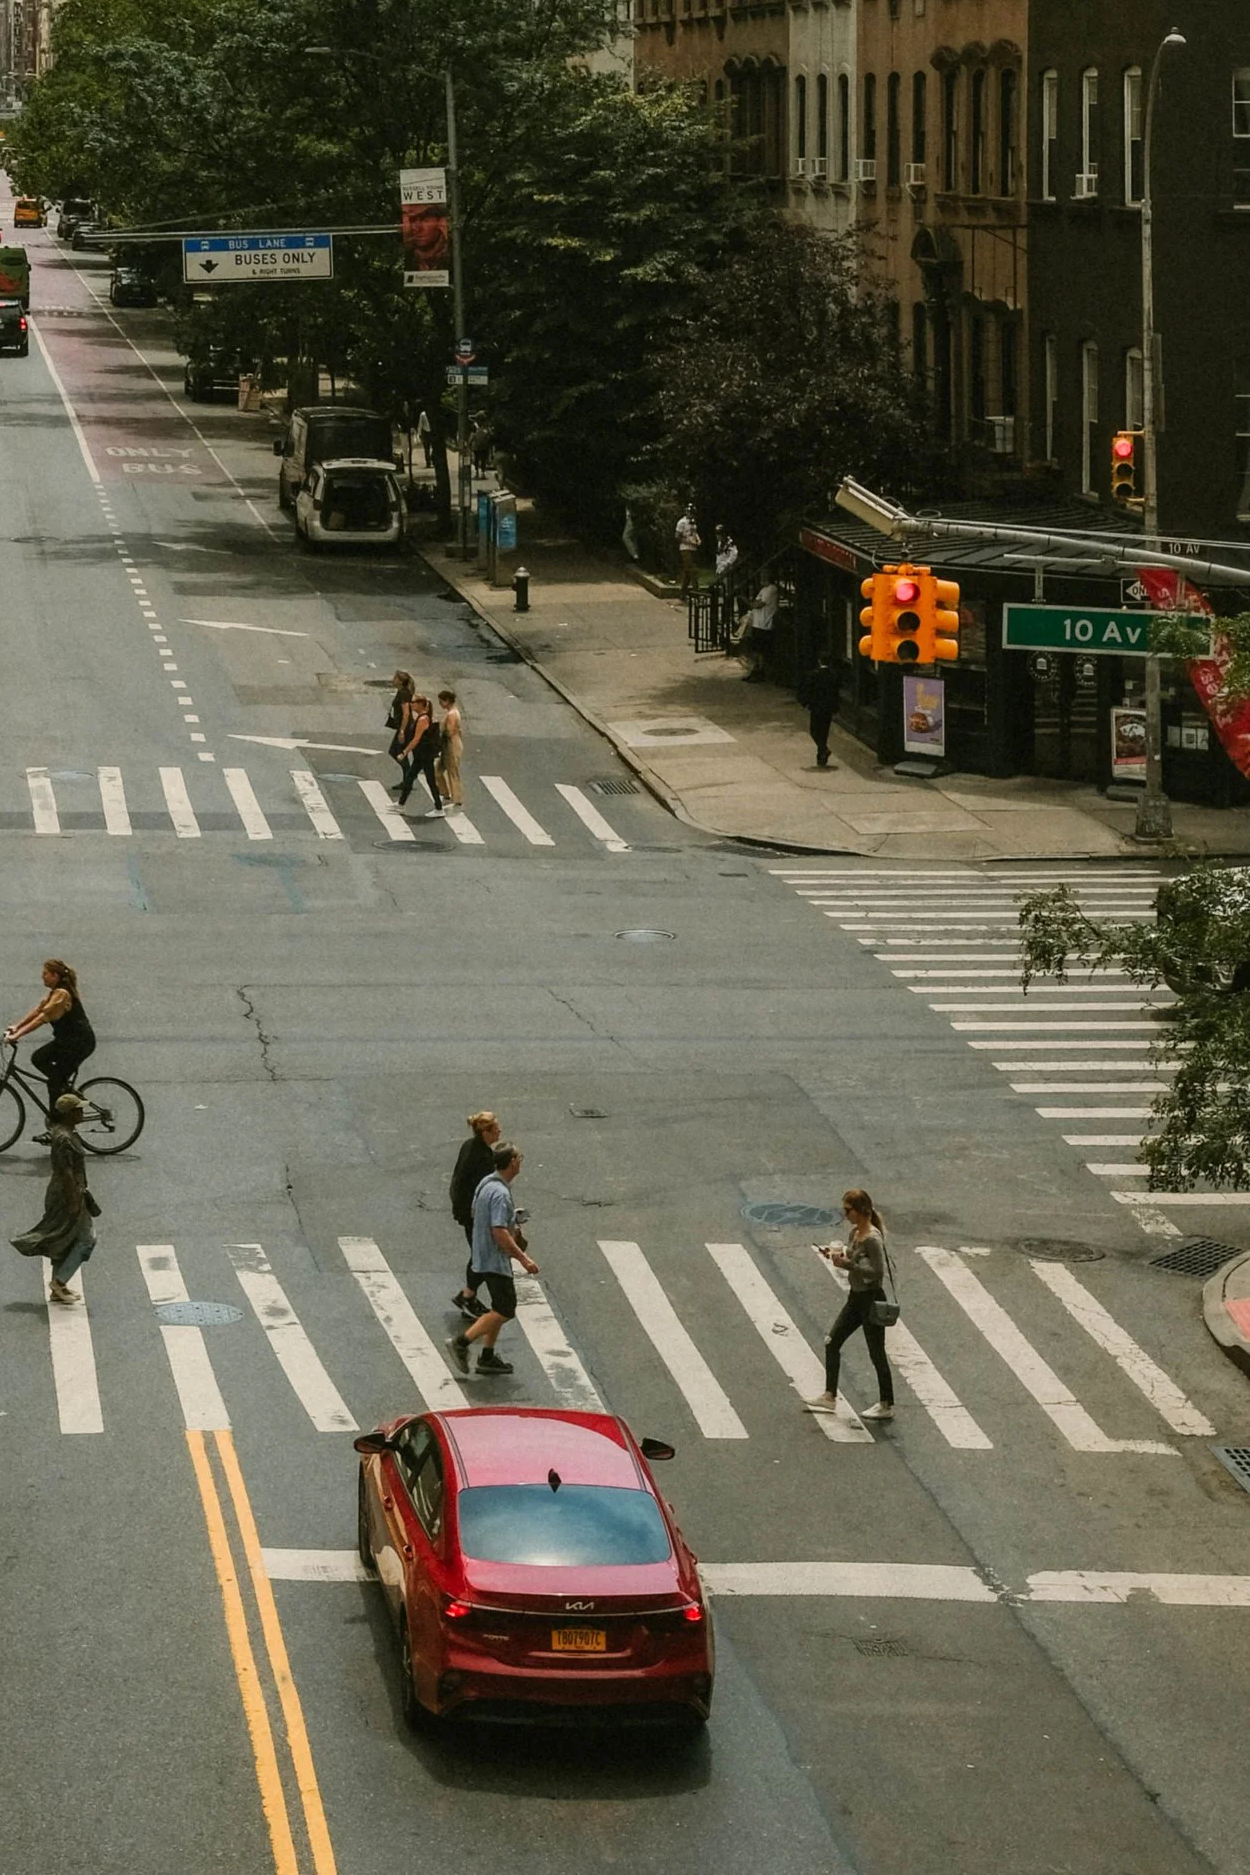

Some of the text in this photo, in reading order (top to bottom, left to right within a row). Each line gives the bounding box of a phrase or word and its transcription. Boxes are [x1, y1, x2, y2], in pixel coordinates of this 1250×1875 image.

[403, 190, 443, 201] WEST
[228, 238, 287, 250] BUS LANE
[235, 252, 316, 266] BUSES ONLY
[105, 447, 194, 458] ONLY
[122, 463, 202, 475] BUS
[1169, 543, 1200, 554] 10 AV
[1063, 618, 1143, 645] 10 Av
[565, 1601, 595, 1611] KIA
